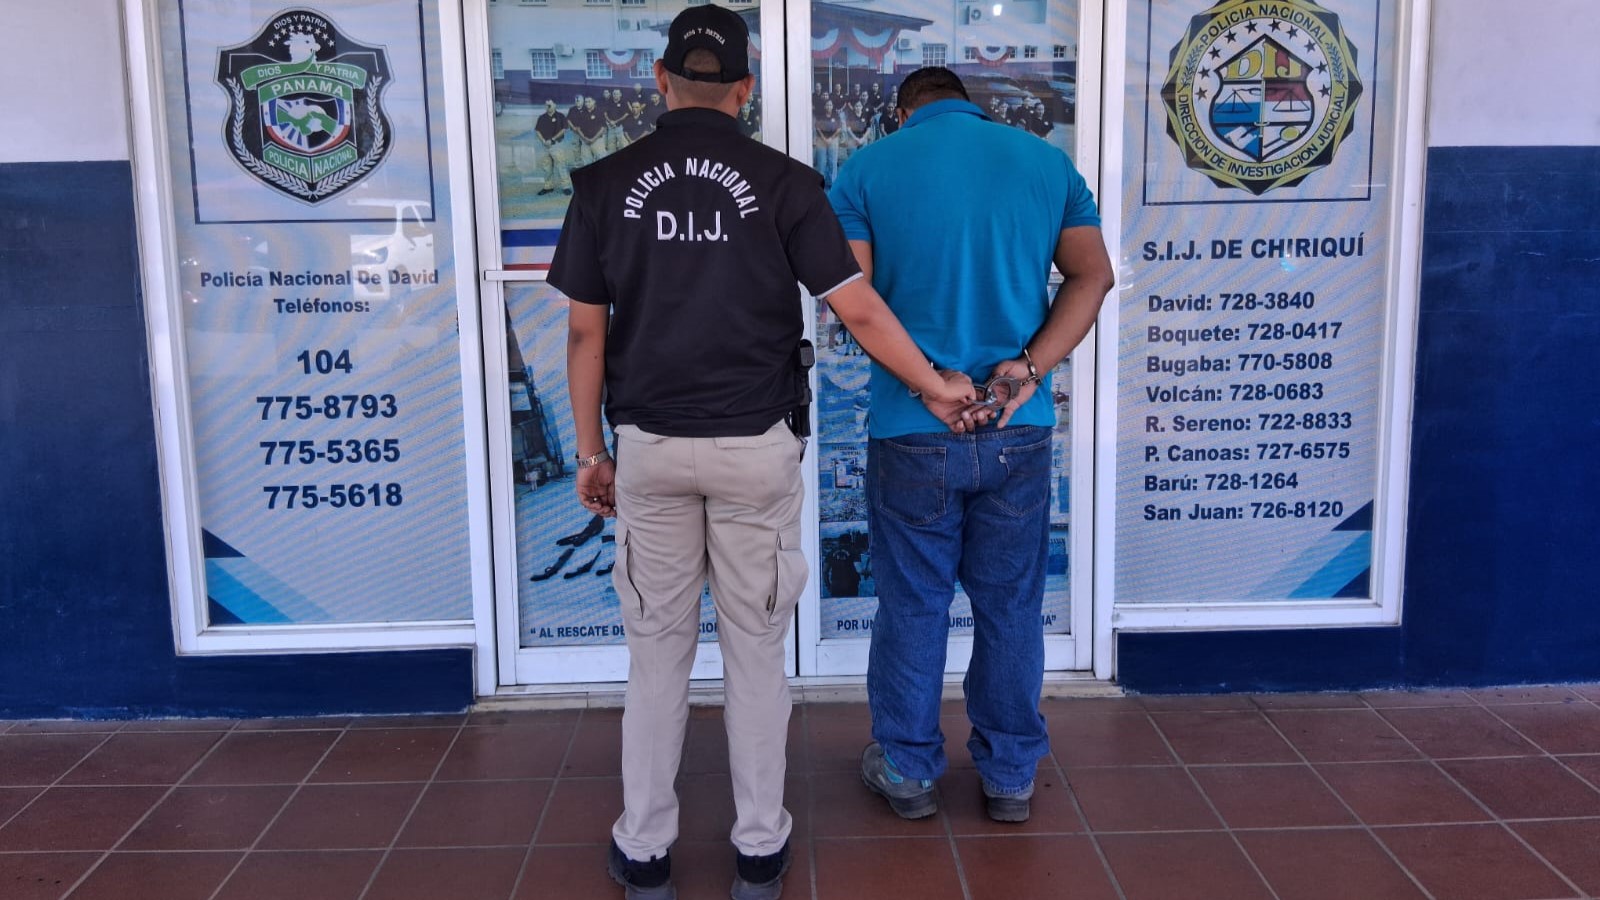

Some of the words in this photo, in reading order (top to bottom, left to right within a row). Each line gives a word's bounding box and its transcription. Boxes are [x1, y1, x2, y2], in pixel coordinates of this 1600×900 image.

[273, 16, 292, 30] DIOS
[300, 14, 327, 30] PATRIA
[1200, 6, 1255, 46] POLICIA
[1259, 4, 1326, 43] NACIONAL
[257, 65, 282, 78] DIOS
[314, 64, 322, 73] Y
[324, 65, 359, 80] PATRIA
[271, 79, 344, 97] PANAMA
[1178, 94, 1212, 157] DIRECCION
[1210, 152, 1228, 169] DE
[1227, 143, 1318, 177] INVESTIGACION
[1319, 92, 1345, 147] JUDICIAL
[269, 151, 308, 178] POLICIA
[624, 162, 675, 219] POLICIA
[685, 157, 759, 219] NACIONAL
[656, 210, 728, 242] D.I.J.
[1143, 240, 1202, 261] S.I.J.
[1211, 239, 1243, 259] DE
[1251, 232, 1364, 258] CHIRIQUÍ
[200, 271, 263, 288] Policía
[269, 270, 351, 287] Nacional
[357, 269, 381, 285] De
[388, 269, 439, 285] David
[273, 298, 370, 314] Teléfonos:
[1148, 294, 1212, 312] David:
[1219, 291, 1315, 311] 728-3840
[1147, 325, 1240, 346] Boquete:
[1247, 322, 1342, 340] 728-0417
[297, 349, 353, 375] 104
[1146, 355, 1231, 376] Bugaba:
[1238, 352, 1333, 371] 770-5808
[1146, 384, 1222, 402] Volcán:
[1229, 383, 1324, 401] 728-0683
[256, 393, 398, 421] 775-8793
[1145, 415, 1165, 433] R.
[1172, 414, 1251, 432] Sereno:
[1258, 412, 1352, 430] 722-8833
[259, 438, 401, 466] 775-5365
[1144, 446, 1160, 462] P.
[1167, 445, 1250, 462] Canoas:
[1256, 442, 1350, 460] 727-6575
[1144, 474, 1198, 492] Barú:
[1204, 472, 1299, 490] 728-1264
[263, 482, 403, 509] 775-5618
[1143, 504, 1181, 521] San
[1188, 503, 1243, 521] Juan:
[1250, 501, 1343, 519] 726-8120
[539, 627, 554, 638] AL
[557, 625, 609, 638] RESCATE
[837, 619, 859, 630] POR
